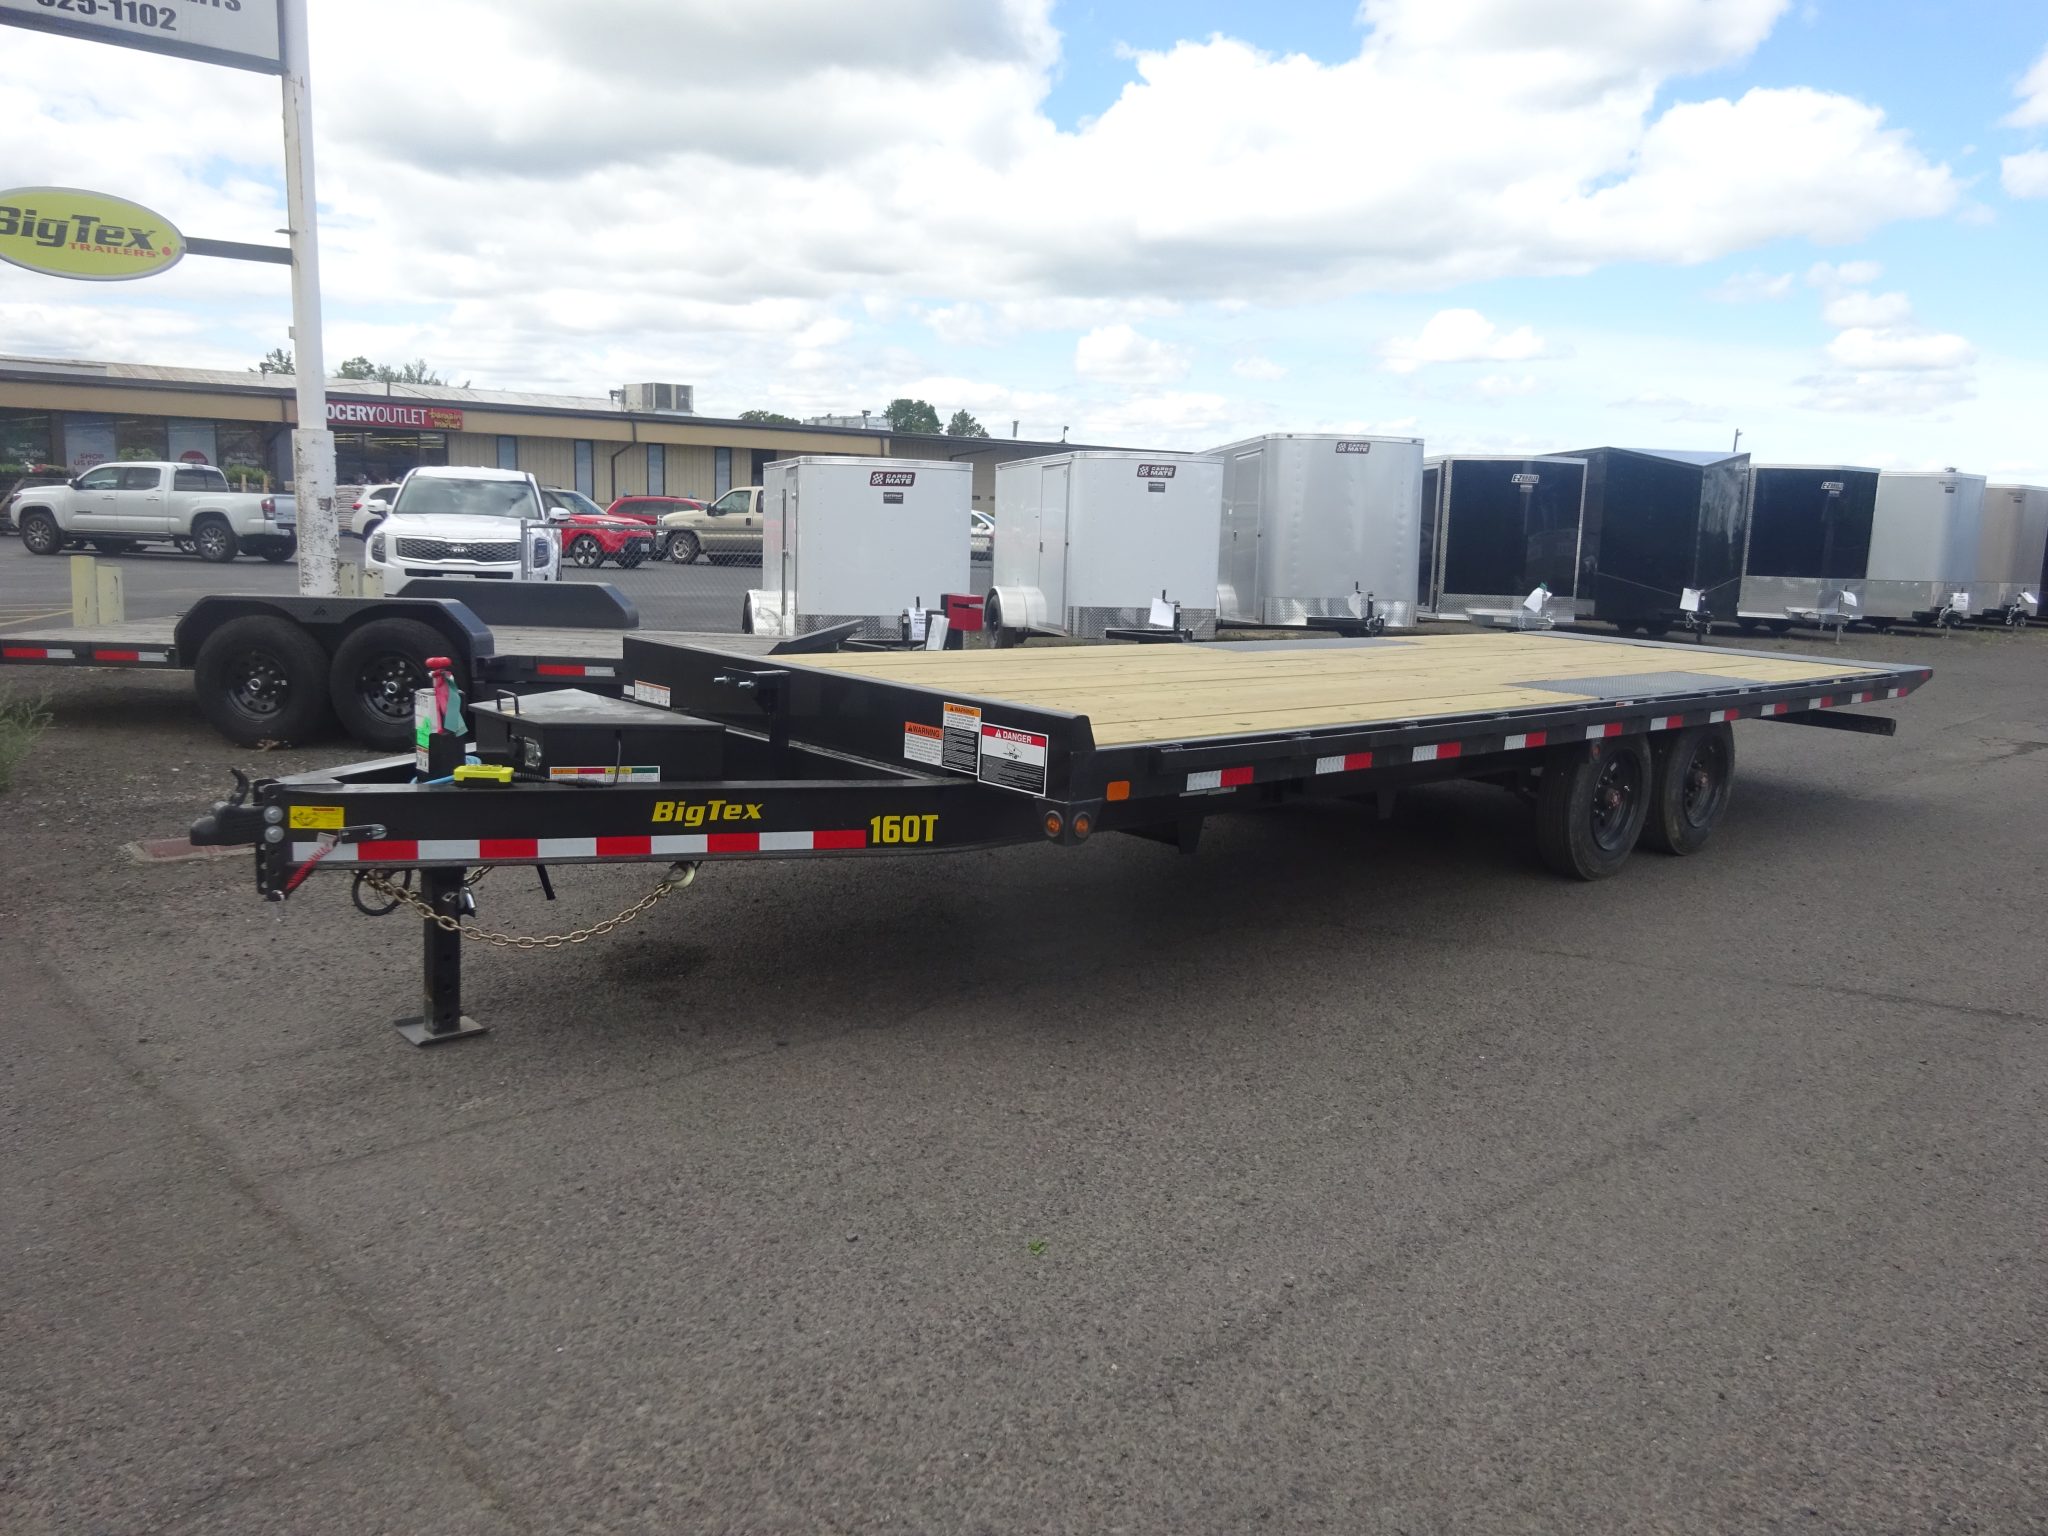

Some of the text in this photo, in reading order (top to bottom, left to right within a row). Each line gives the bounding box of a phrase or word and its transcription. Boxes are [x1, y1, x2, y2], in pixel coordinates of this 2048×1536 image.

[0, 206, 156, 250] BigTex
[68, 242, 157, 258] TRAILERS
[912, 725, 940, 738] WARNING
[1002, 730, 1032, 744] DANGER
[651, 800, 764, 827] BigTex
[869, 814, 939, 844] 160T
